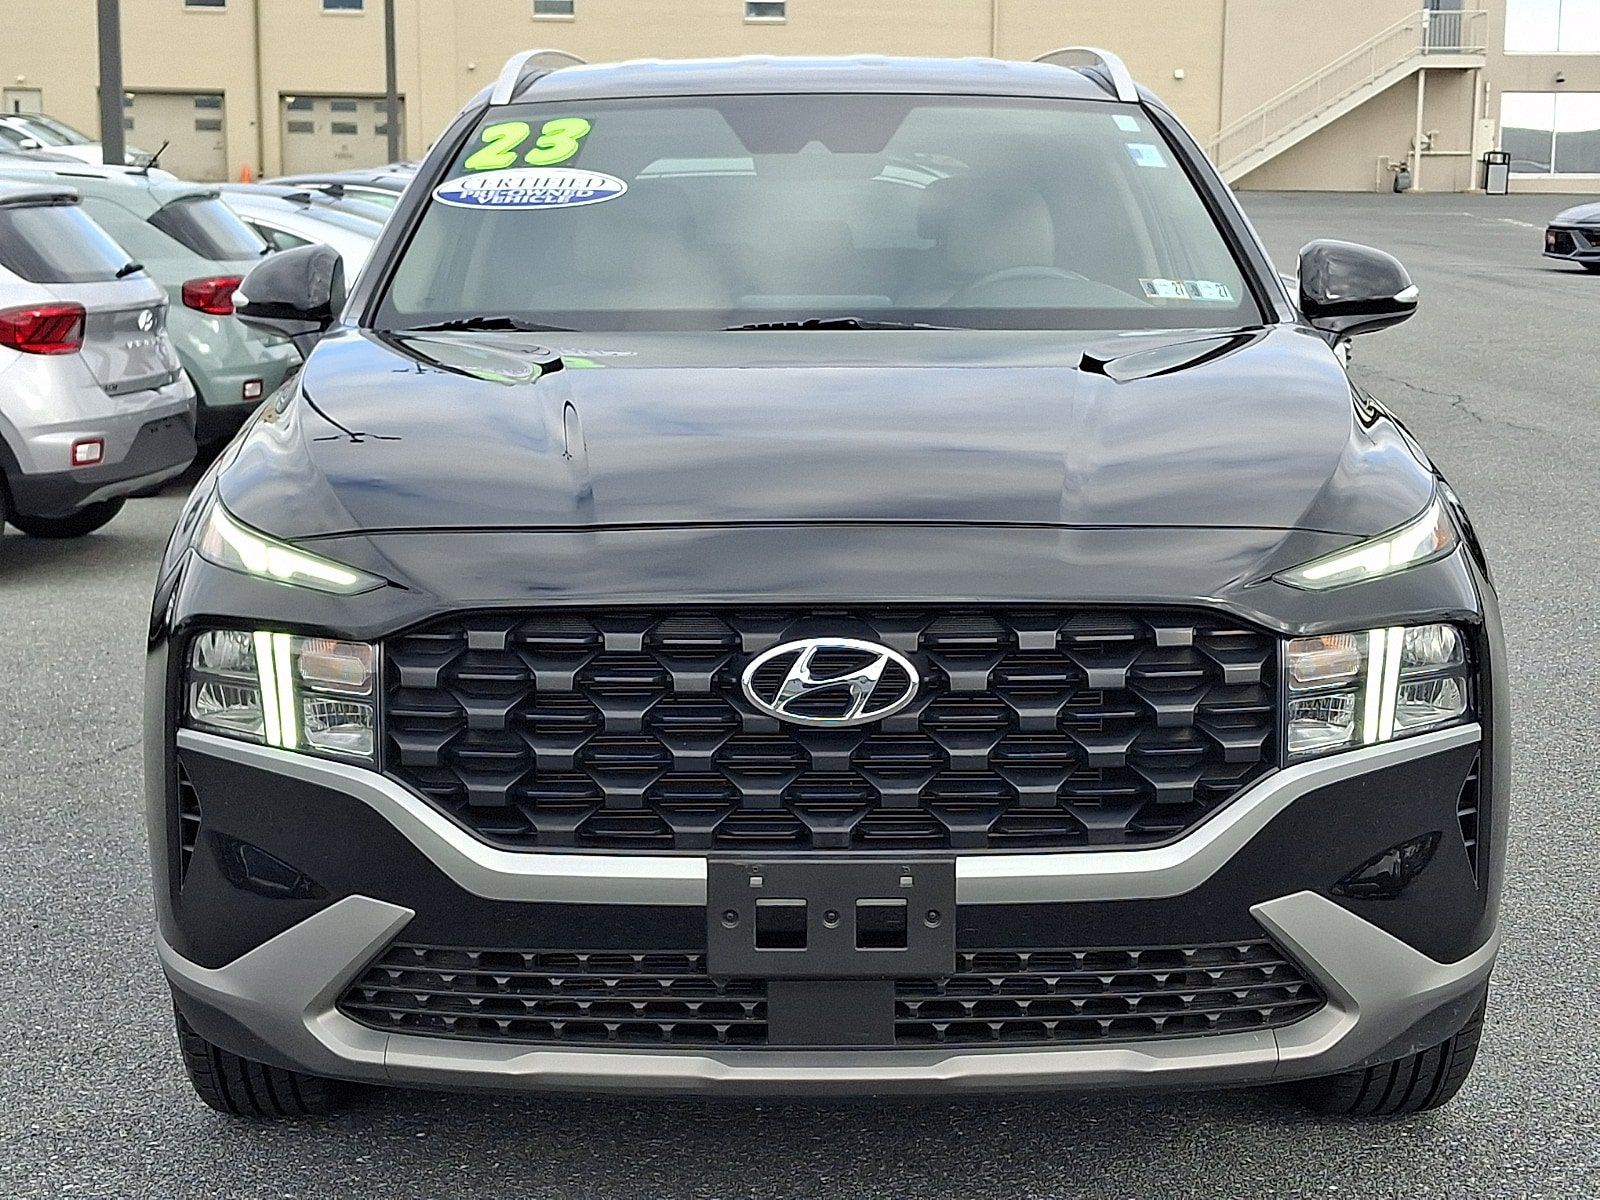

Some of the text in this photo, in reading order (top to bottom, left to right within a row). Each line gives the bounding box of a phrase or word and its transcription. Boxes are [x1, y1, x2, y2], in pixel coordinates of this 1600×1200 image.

[464, 117, 591, 170] 23
[460, 177, 606, 190] CERTIFIED
[477, 192, 572, 204] VEHICLE
